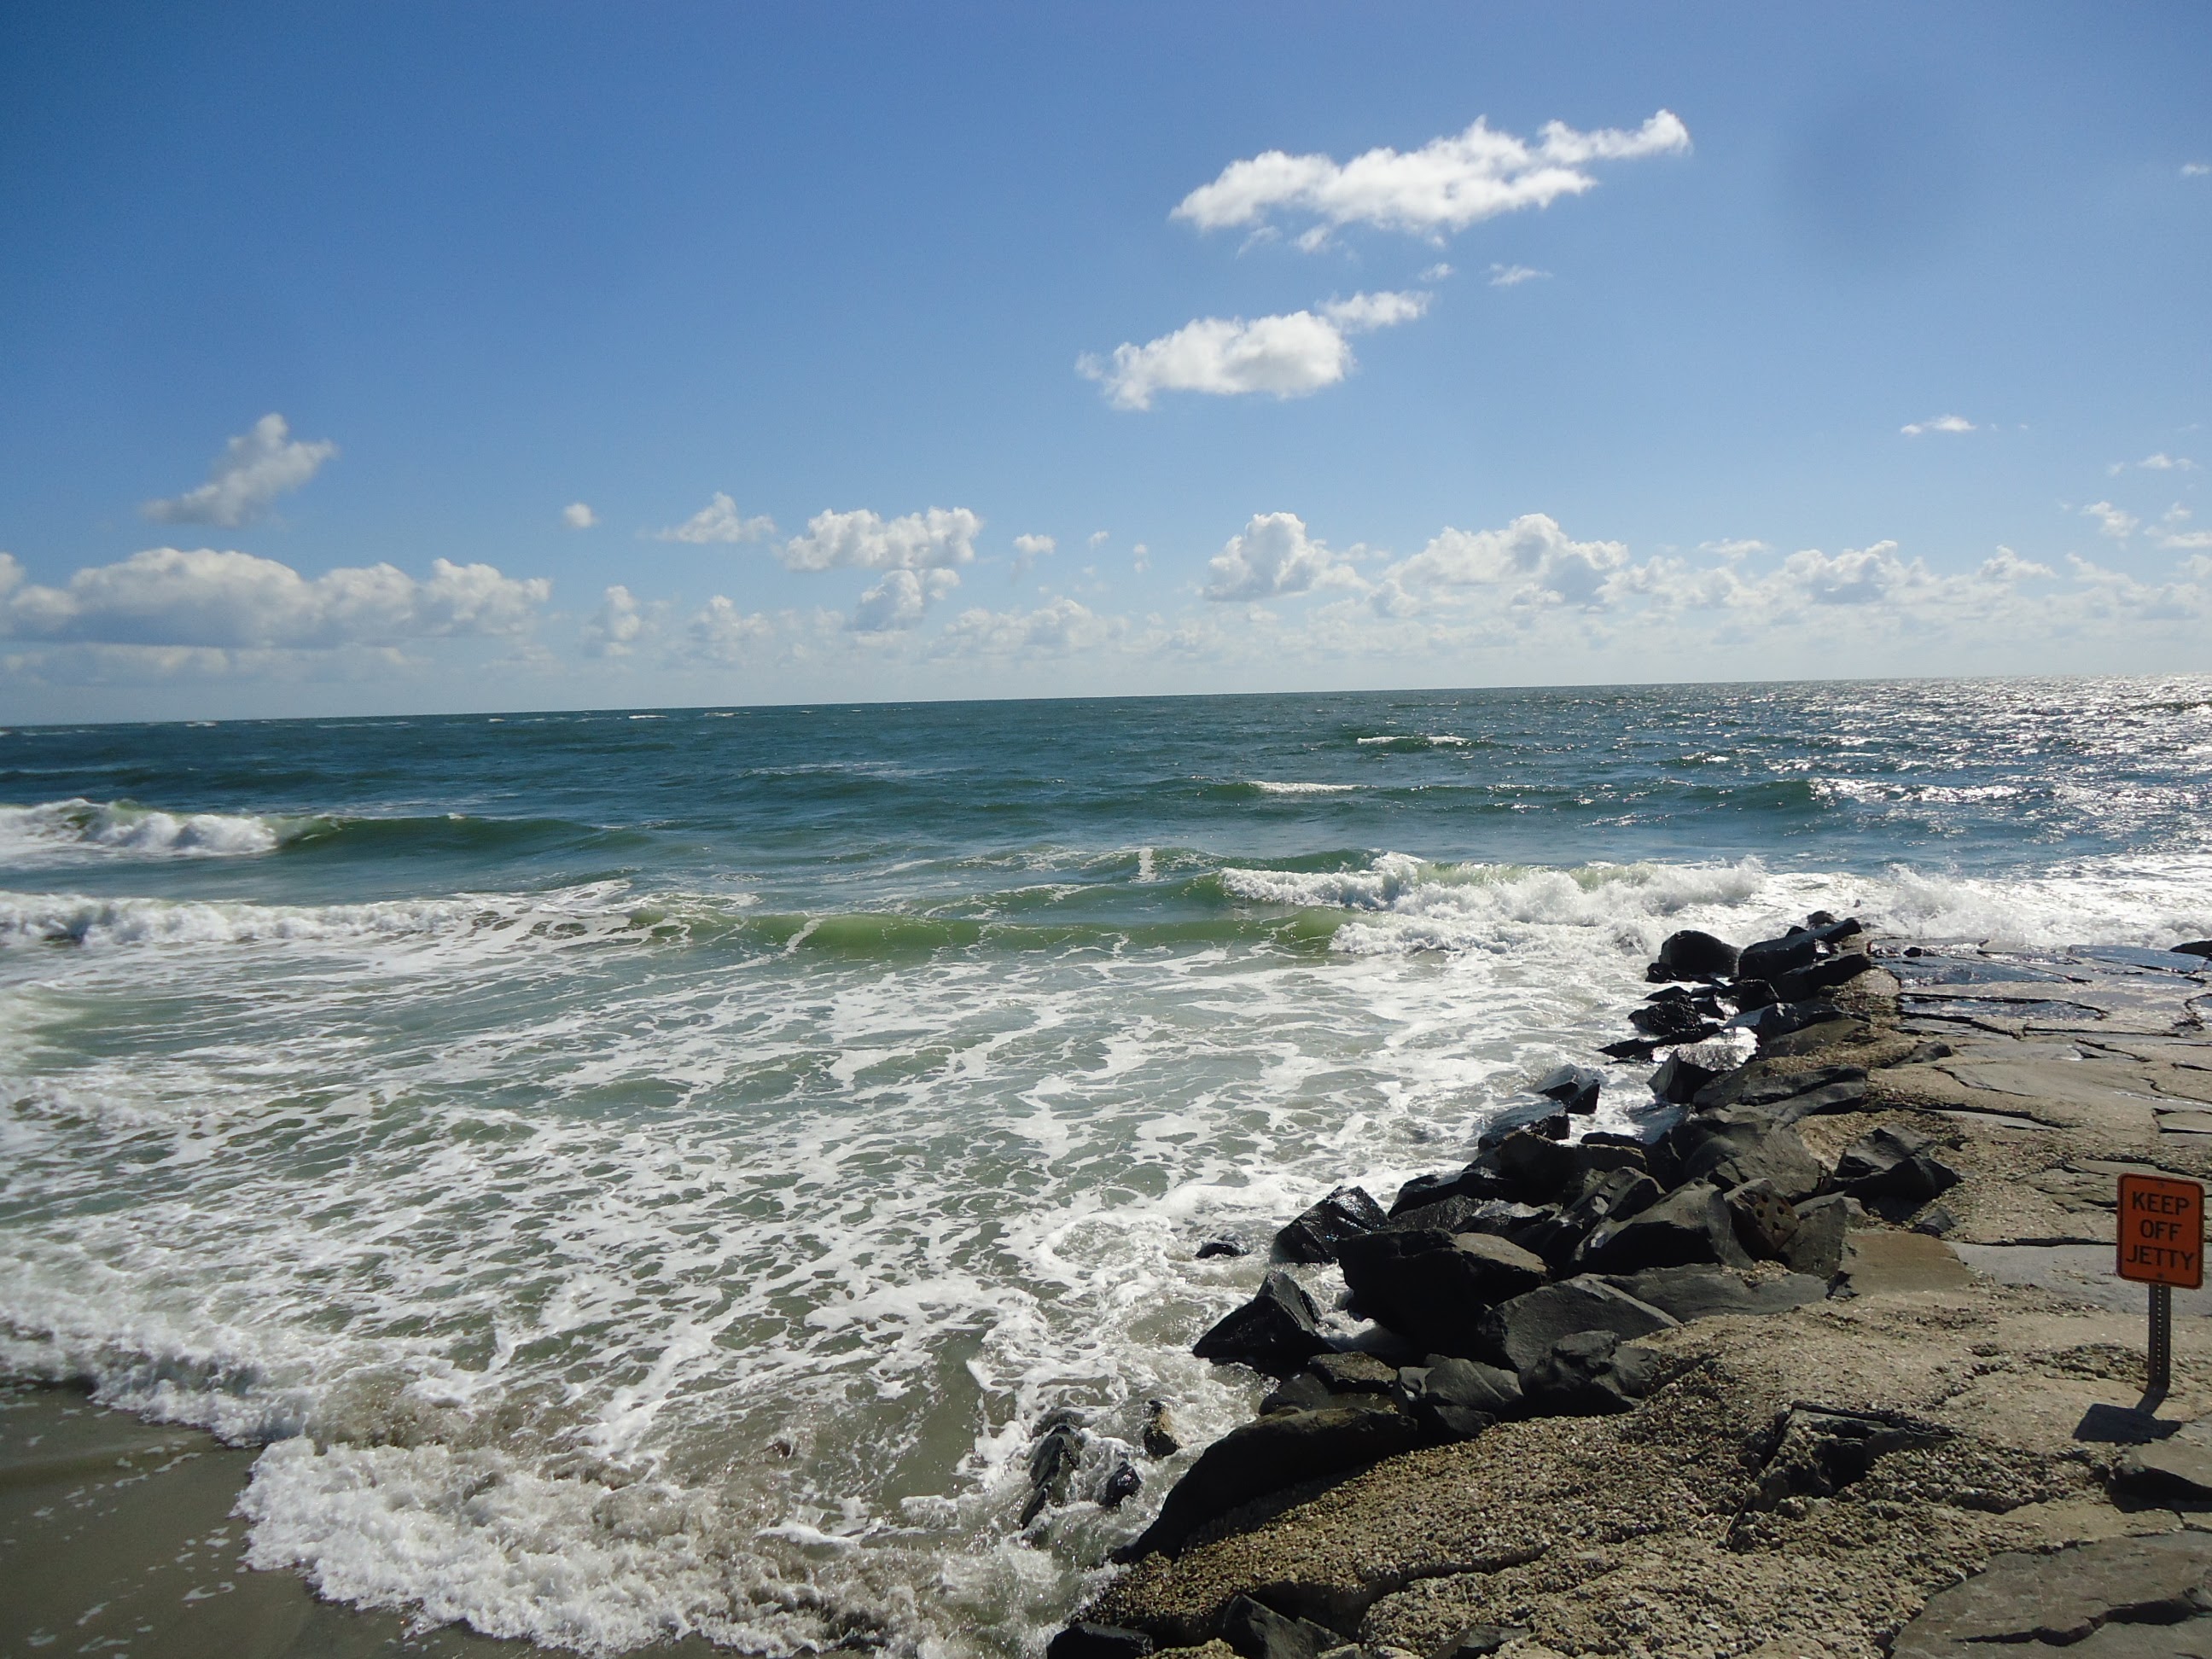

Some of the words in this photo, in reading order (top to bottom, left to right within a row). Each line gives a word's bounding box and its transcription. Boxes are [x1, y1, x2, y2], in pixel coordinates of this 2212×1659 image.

[2132, 1191, 2190, 1215] KEEP
[2139, 1220, 2183, 1241] OFF
[2126, 1245, 2194, 1271] JETTY
